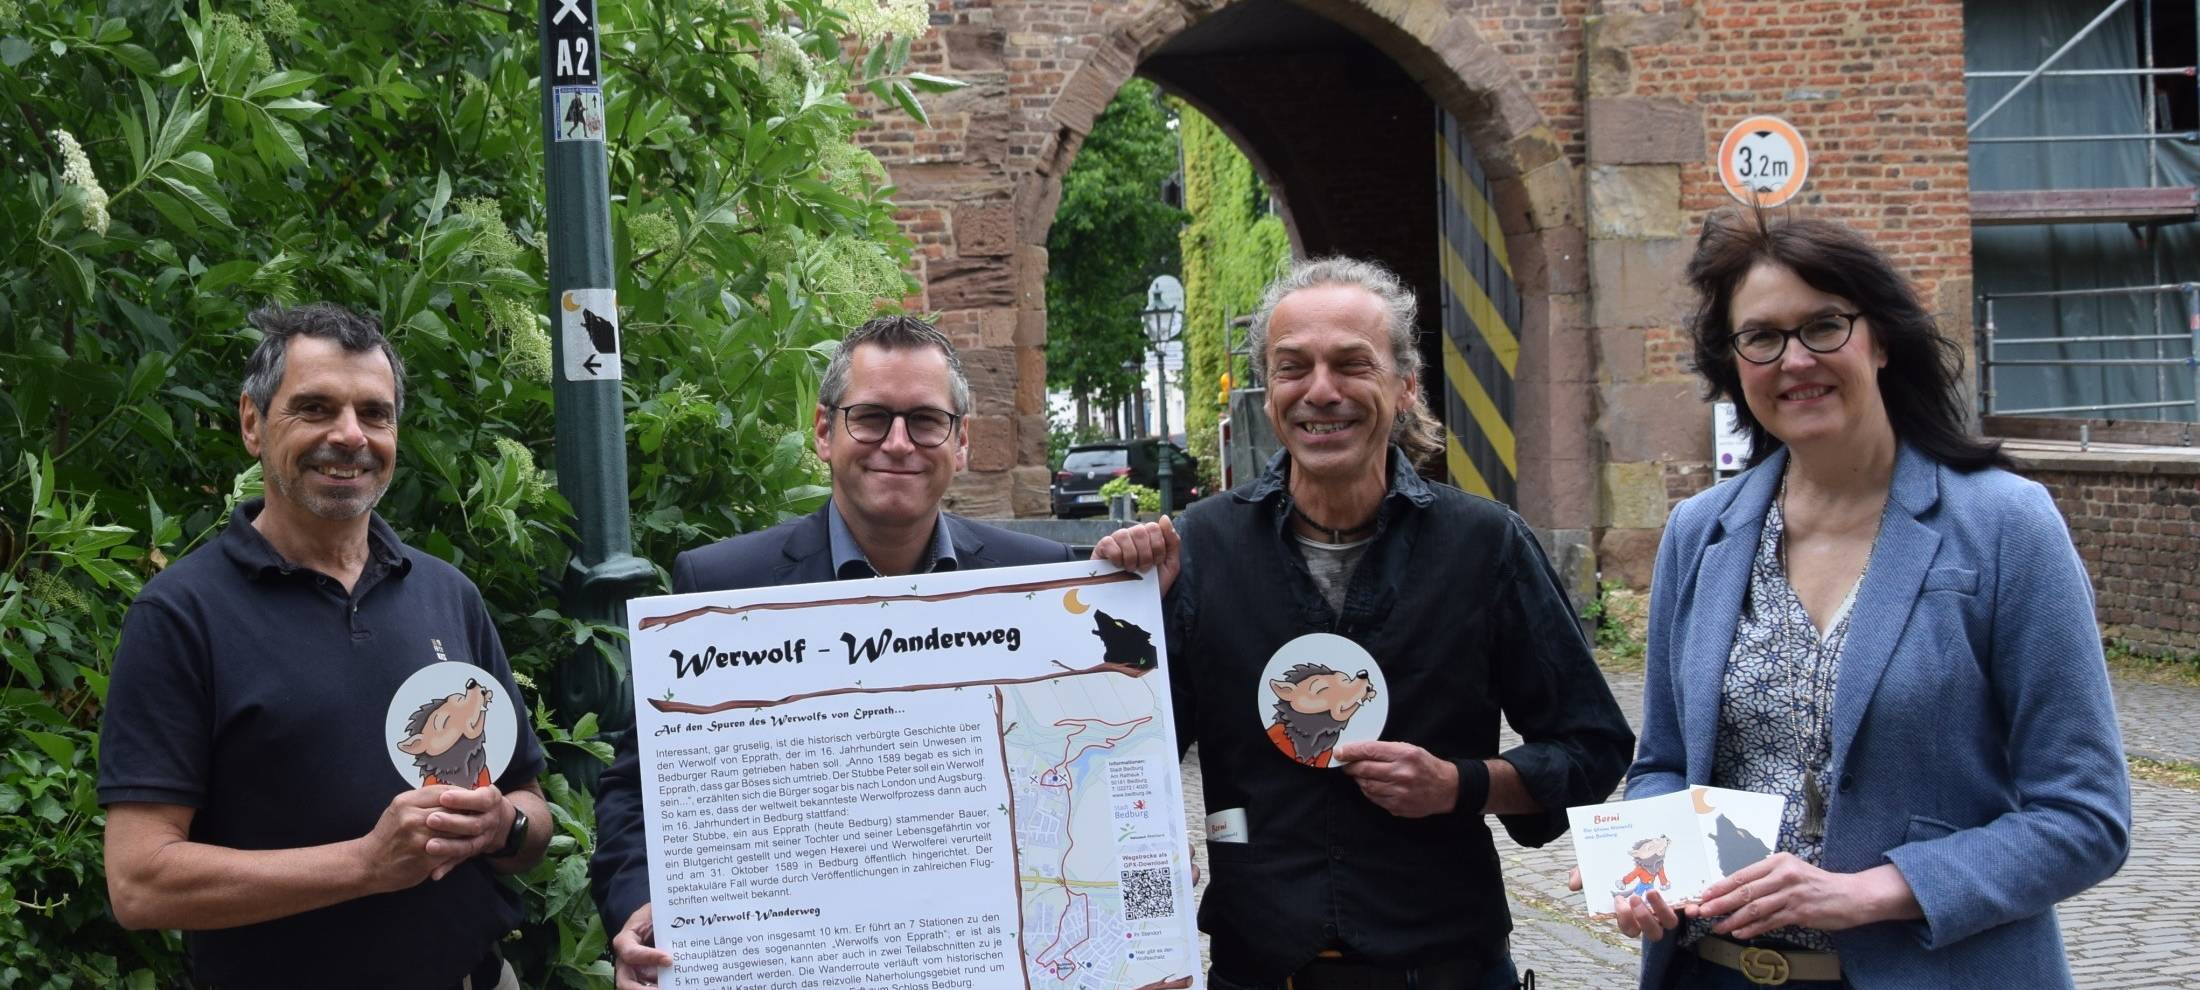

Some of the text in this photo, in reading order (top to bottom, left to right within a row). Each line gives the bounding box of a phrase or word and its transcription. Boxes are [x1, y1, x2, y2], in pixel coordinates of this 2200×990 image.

[557, 37, 590, 76] A2
[669, 638, 806, 679] Werwolf
[840, 627, 1021, 665] Wanderweg
[654, 723, 681, 736] Auf
[685, 722, 702, 732] den
[706, 720, 745, 732] Spuren
[748, 717, 766, 726] des
[770, 711, 827, 726] Werwolfs
[714, 744, 729, 755] gar
[776, 738, 787, 747] ist
[790, 737, 804, 746] die
[807, 733, 852, 744] historisch
[855, 729, 900, 740] verbürgte
[903, 724, 956, 736] Geschichte
[959, 722, 980, 731] über
[657, 771, 707, 782] Bedburger
[710, 768, 738, 778] Raum
[742, 764, 786, 777] getrieben
[789, 761, 819, 771] haben
[878, 753, 900, 763] 1589
[903, 750, 933, 762] begab
[678, 756, 716, 768] Werwolf
[839, 742, 895, 754] Jahrhundert
[899, 741, 918, 749] sein
[922, 736, 966, 747] Unwesen
[696, 793, 739, 804] erzählten
[778, 787, 810, 797] Bürger
[812, 784, 839, 795] sogar
[856, 780, 879, 790] nach
[881, 777, 916, 788] London
[700, 782, 722, 791] dass
[832, 770, 849, 779] Der
[851, 767, 884, 778] Stubbe
[886, 765, 911, 775] Peter
[912, 763, 929, 772] soll
[946, 758, 984, 769] Werwolf
[676, 783, 986, 817] kam dass weltweit bekannteste Werwolfprozess dann auch
[1115, 810, 1149, 819] Bedburg
[663, 834, 688, 844] Peter
[772, 823, 809, 836] Epprath
[895, 811, 954, 824] stammender
[693, 816, 750, 828] Jahrhundert
[763, 812, 803, 822] Bedburg
[663, 821, 972, 856] wurde gemeinsam seiner Tochter seiner Lebensgefährtin
[683, 832, 992, 867] Blutgericht gestellt wegen Hexerei Werwolferei verurteilt
[666, 871, 683, 881] und
[731, 865, 768, 875] Oktober
[775, 861, 798, 871] 1589
[818, 858, 858, 868] Bedburg
[864, 852, 906, 864] öffentlich
[975, 845, 993, 854] Der
[667, 881, 726, 894] spektakuläre
[730, 878, 747, 888] Fall
[749, 876, 779, 886] wurde
[781, 873, 808, 883] durch
[912, 860, 966, 872] zahlreichen
[969, 858, 994, 868] Flug-
[668, 894, 708, 906] schriften
[710, 890, 748, 902] weltweit
[670, 916, 695, 928] Der
[671, 939, 687, 948] hat
[690, 938, 710, 947] eine
[713, 936, 743, 946] Länge
[746, 934, 763, 942] von
[767, 928, 816, 941] insgesamt
[820, 926, 831, 936] 10
[869, 922, 891, 932] führt
[918, 917, 963, 927] Stationen
[981, 913, 999, 922] den
[673, 963, 718, 973] Rundweg
[790, 955, 813, 964] kann
[817, 952, 838, 961] aber
[841, 949, 865, 959] auch
[880, 946, 901, 956] zwei
[905, 940, 975, 954] Teilabschnitten
[764, 941, 826, 954] sogenannten
[684, 976, 699, 984] km
[703, 972, 753, 985] gewandert
[798, 966, 814, 975] Die
[883, 956, 919, 968] verläuft
[922, 956, 942, 965] vom
[946, 950, 1003, 962] historischen
[770, 980, 797, 990] durch
[801, 978, 818, 988] das
[822, 975, 861, 986] reizvolle
[964, 964, 985, 974] rund
[891, 982, 929, 990] Schloss
